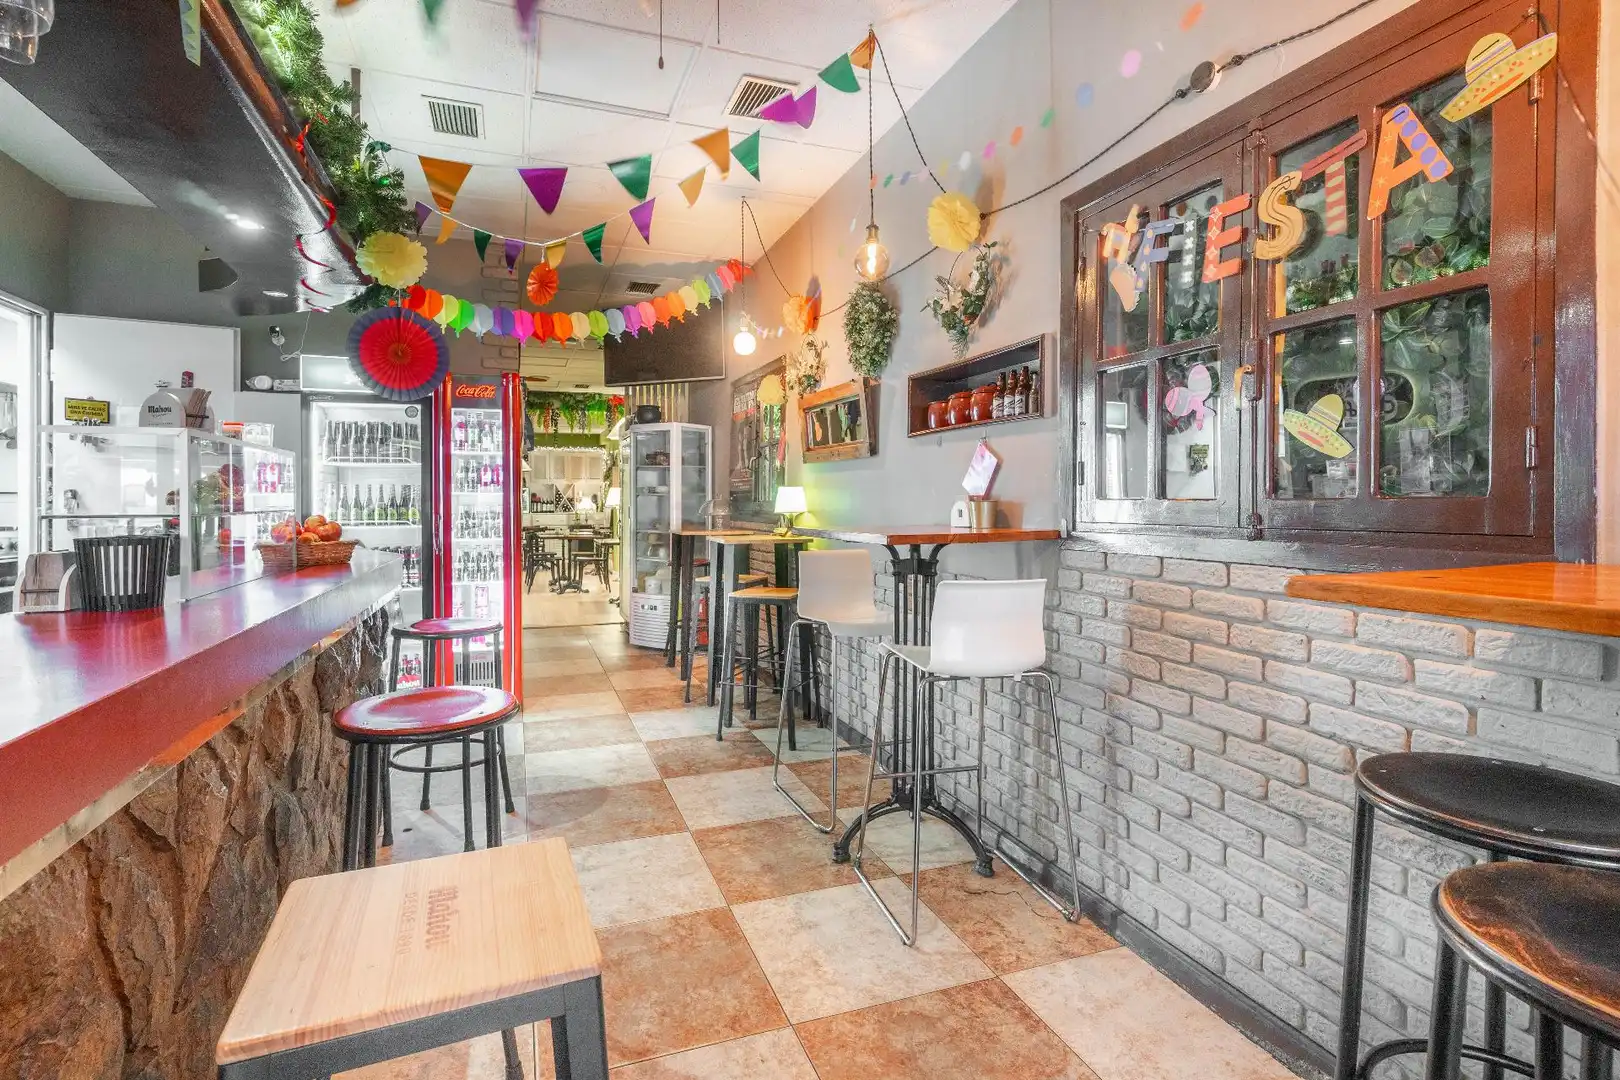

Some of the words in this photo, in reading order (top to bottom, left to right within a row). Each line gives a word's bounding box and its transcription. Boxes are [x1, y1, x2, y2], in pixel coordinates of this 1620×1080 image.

[1134, 103, 1454, 292] FIESTA
[147, 405, 172, 413] Mahou
[425, 887, 459, 949] Mahou
